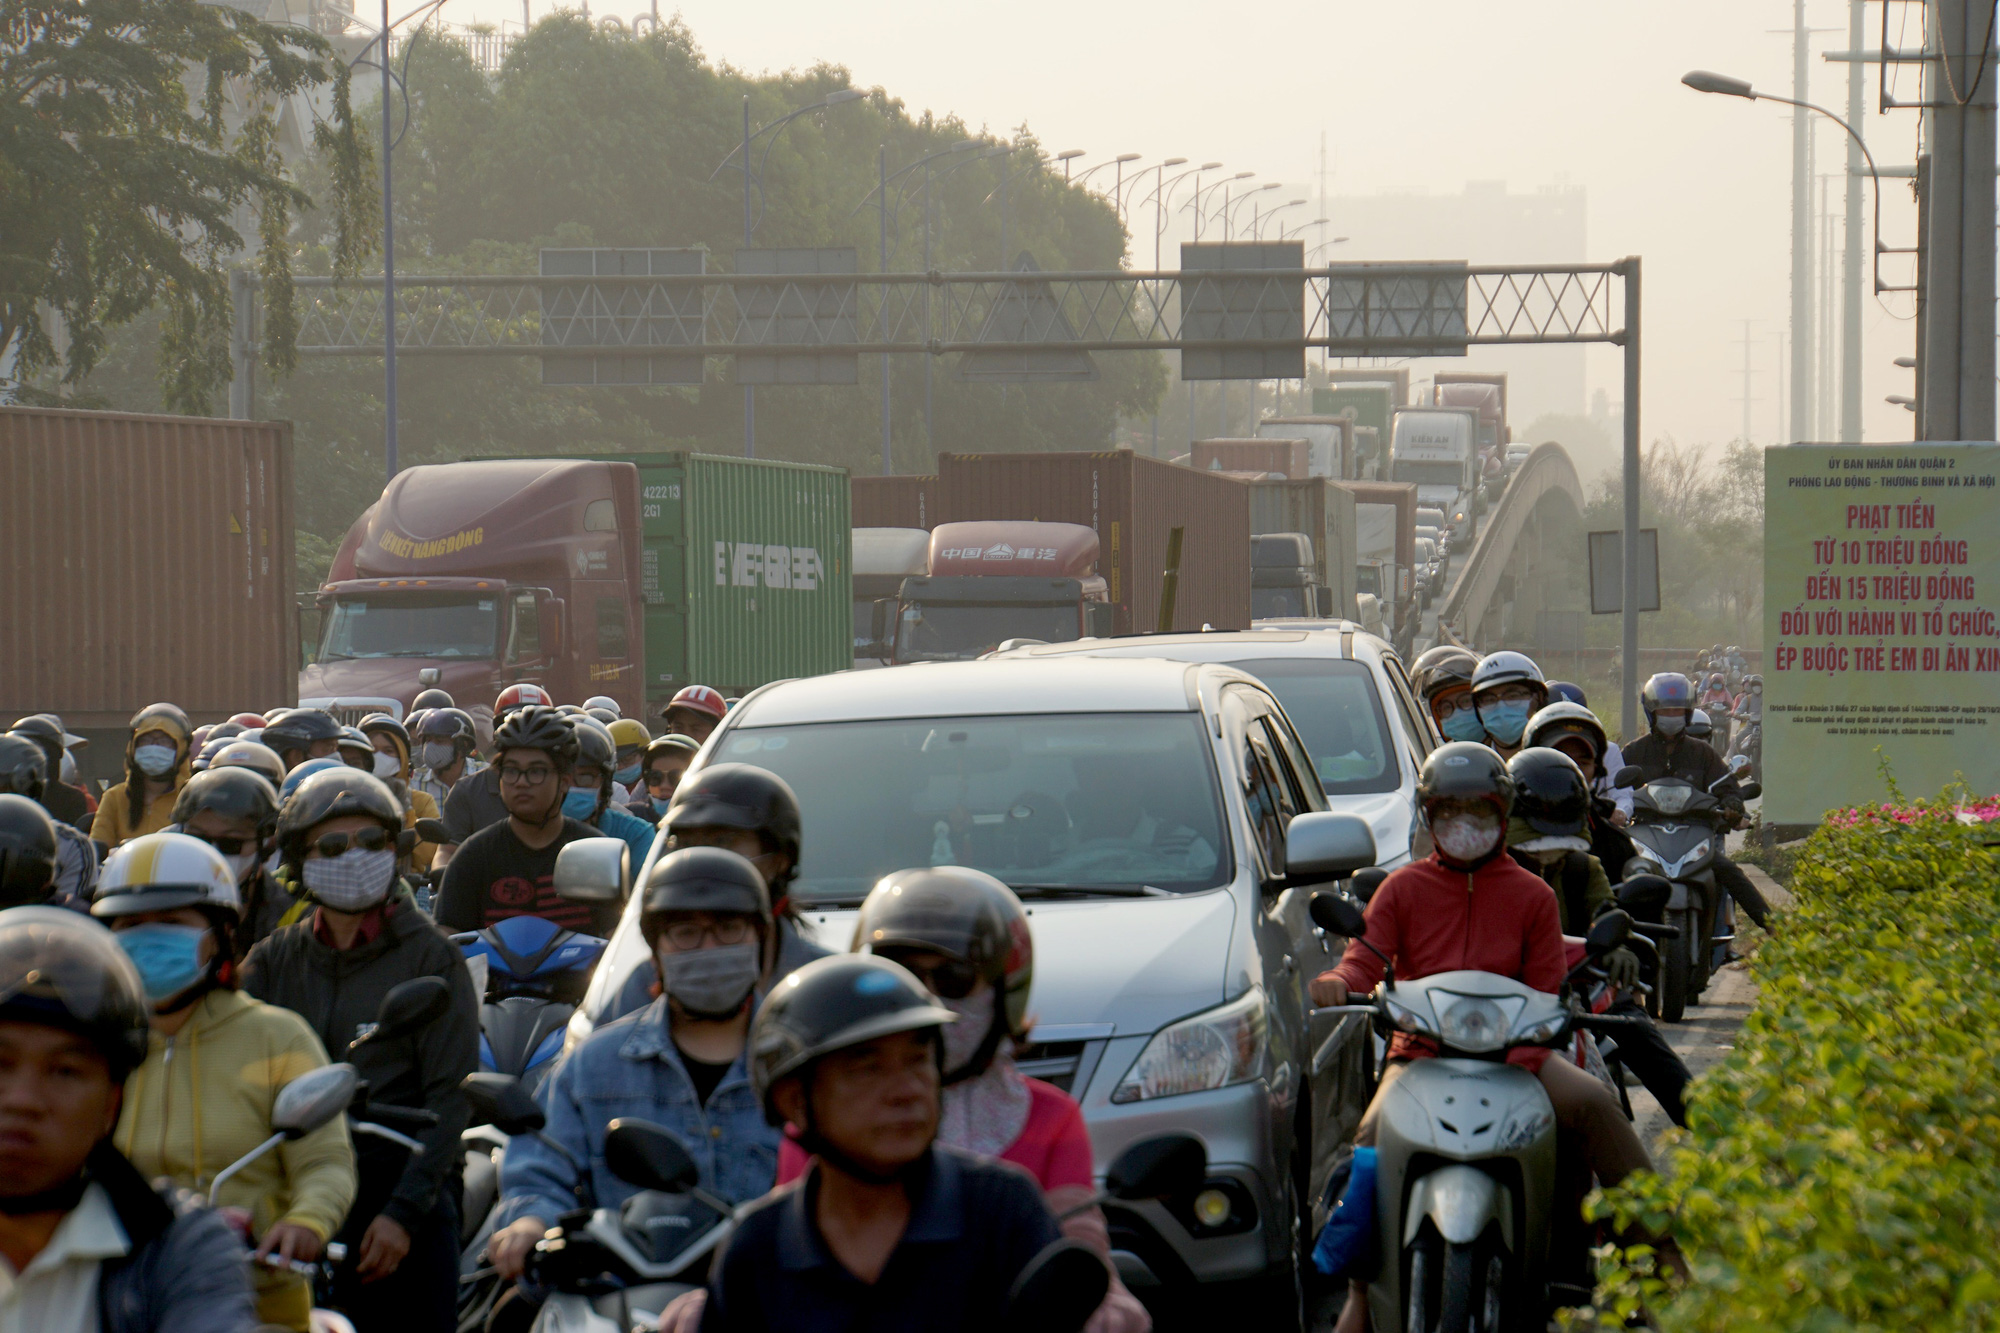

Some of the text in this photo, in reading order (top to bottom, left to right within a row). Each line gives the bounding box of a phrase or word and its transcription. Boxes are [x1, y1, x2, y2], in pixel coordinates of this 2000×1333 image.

[1844, 458, 1864, 469] BAN
[1866, 456, 1894, 469] NHÂN
[1896, 456, 1917, 469] DÂN
[1919, 456, 1946, 471] QUẬN
[1948, 458, 1956, 468] 2
[1788, 474, 1821, 487] PHÒNG
[1824, 477, 1842, 487] LAO
[1844, 475, 1871, 490] ĐỘNG
[1880, 475, 1918, 487] THƯƠNG
[1921, 477, 1944, 487] BINH
[1948, 474, 1960, 487] VÀ
[1963, 474, 1976, 487] XÃ
[1979, 474, 1996, 488] HỘI
[1847, 496, 1935, 534] PHẠT TIỀN
[941, 548, 982, 560] 中国
[1016, 548, 1057, 560] 重汽
[1814, 532, 1968, 570] TỪ 10 TRIỆU ĐỒNG
[1807, 568, 1974, 606] ĐẾN 15 TRIỆU ĐỒNG
[1780, 603, 1810, 636] ĐỐI
[1814, 606, 1842, 636] VỚI
[1849, 606, 1895, 636] HÀNH
[1900, 611, 1916, 636] VI
[1922, 602, 1944, 636] TỔ
[1776, 642, 1798, 671] ÉP
[1803, 642, 1848, 676] BUỘC
[1854, 638, 1886, 671] TRẺ
[1890, 646, 1917, 672] EM
[1922, 646, 1940, 672] ĐI
[1946, 642, 1970, 672] ĂN
